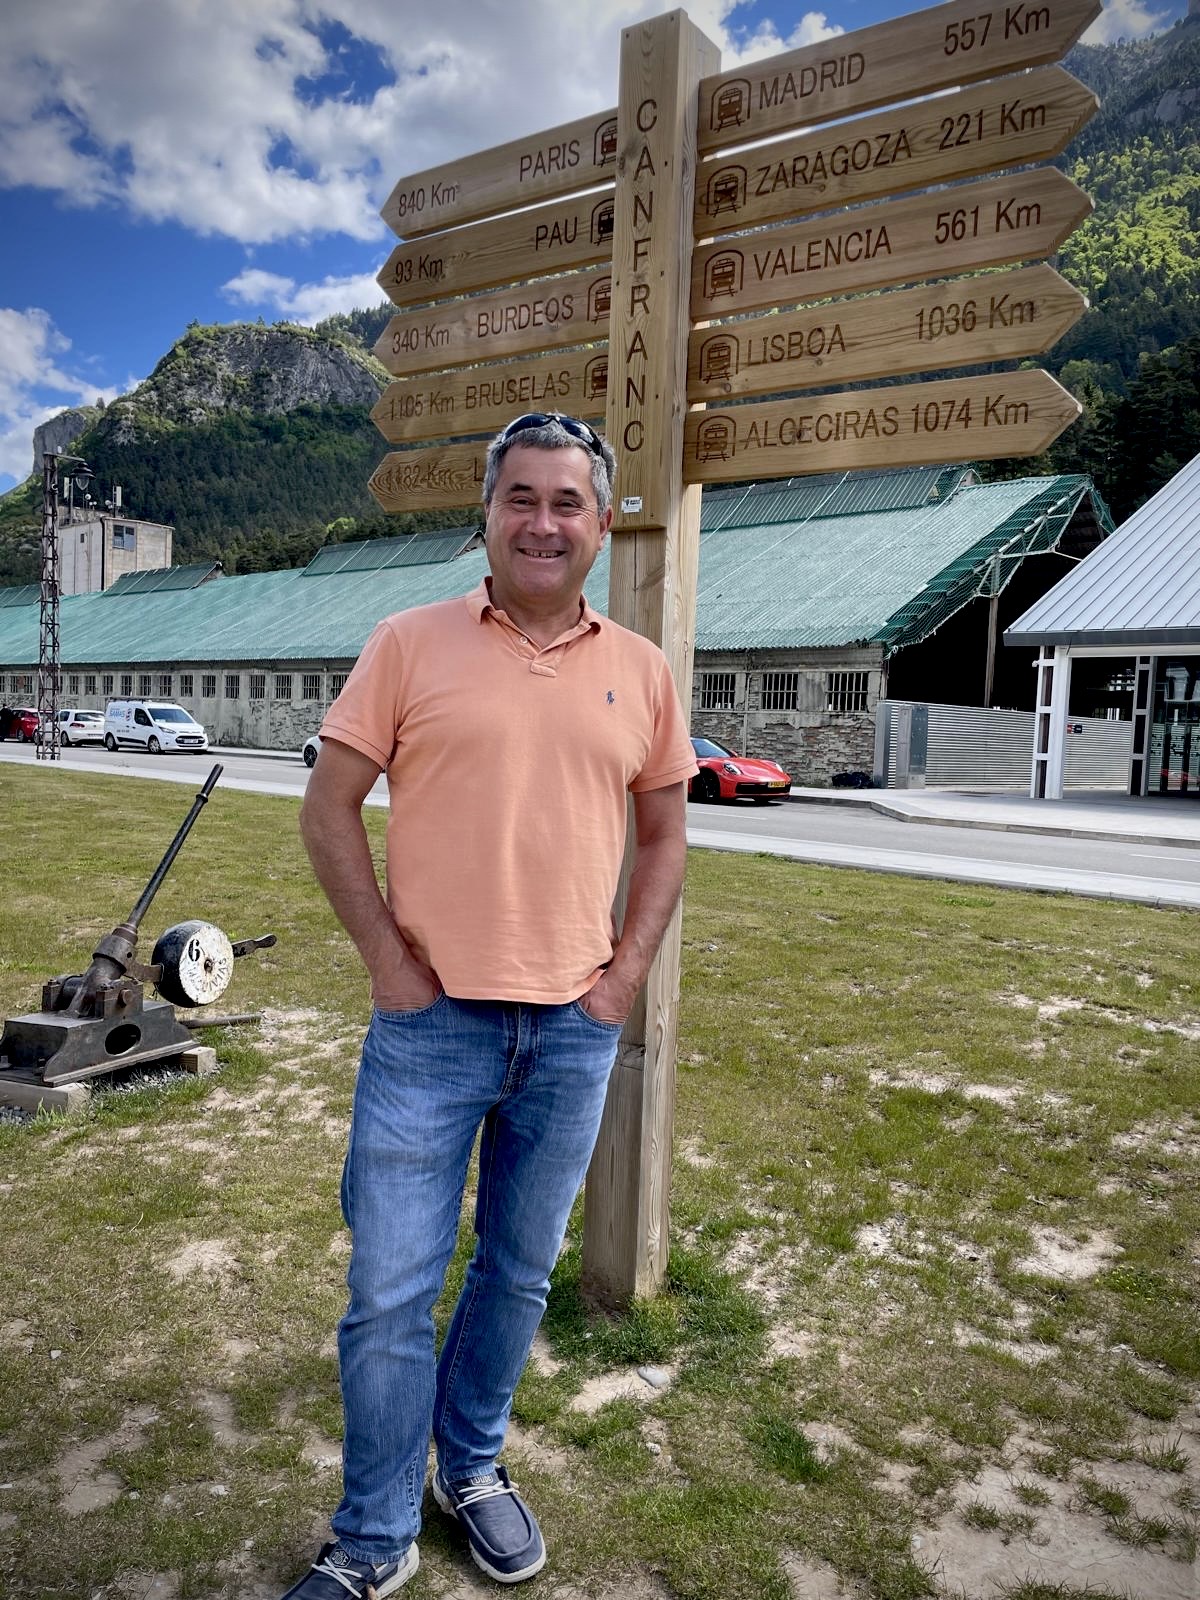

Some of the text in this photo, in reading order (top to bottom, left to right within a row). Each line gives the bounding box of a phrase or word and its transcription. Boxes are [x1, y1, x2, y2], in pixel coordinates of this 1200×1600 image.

[944, 2, 1050, 56] 557 Km
[758, 52, 865, 110] MADRID
[938, 99, 1046, 152] 221 Km
[519, 139, 580, 182] PARIS
[755, 129, 912, 197] ZARAGOZA
[398, 181, 457, 218] 840 Km
[934, 197, 1041, 245] 561 Km
[535, 216, 578, 250] PAU
[754, 225, 892, 281] VALENCIA
[395, 253, 443, 285] 93 Km
[623, 98, 658, 452] CANFRANC
[392, 322, 449, 354] 340 Km
[477, 294, 574, 338] BURDEOS
[915, 294, 1035, 340] 1036 Km
[747, 324, 846, 367] LISBOA
[390, 370, 571, 420] 1105 Km BRUSELAS
[744, 394, 1029, 450] ALGECIRAS 1074 Km
[188, 939, 200, 962] 6
